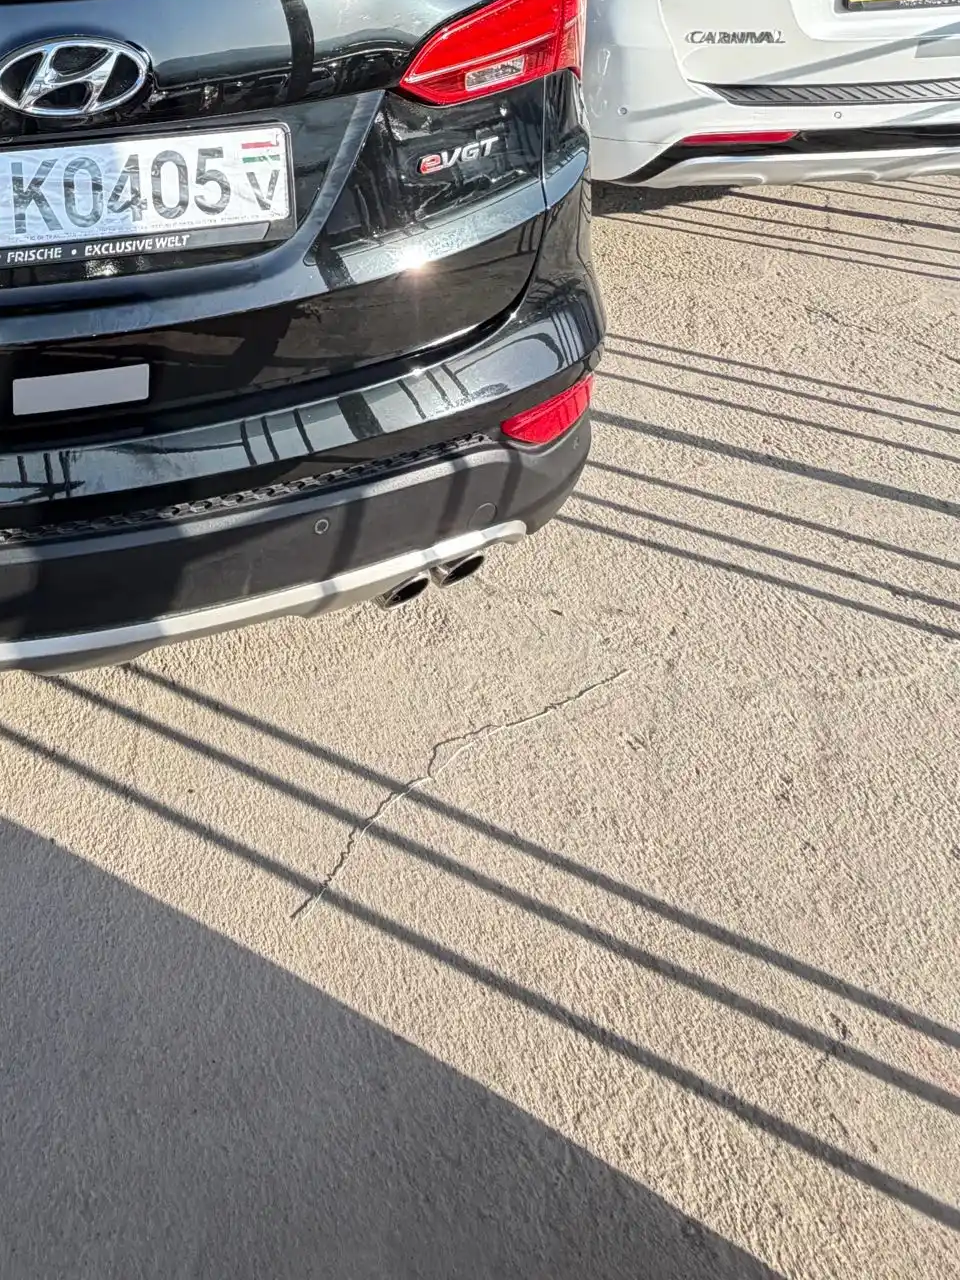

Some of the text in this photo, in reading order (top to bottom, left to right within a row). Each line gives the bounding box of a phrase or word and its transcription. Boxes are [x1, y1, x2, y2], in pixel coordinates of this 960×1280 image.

[685, 30, 786, 44] CARNIVAL
[10, 146, 232, 235] K0405
[6, 245, 63, 264] FRISCHE
[84, 238, 154, 258] EXCLUSIVE
[155, 234, 191, 252] WELT
